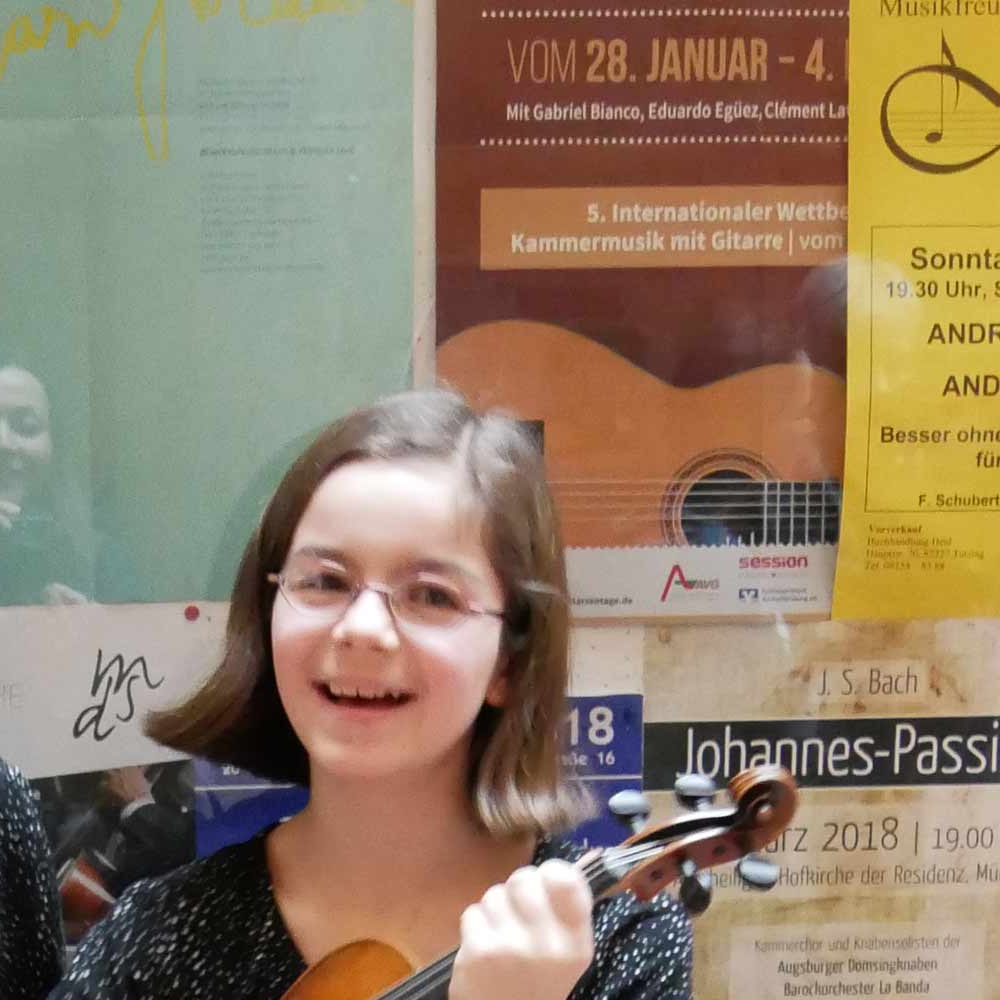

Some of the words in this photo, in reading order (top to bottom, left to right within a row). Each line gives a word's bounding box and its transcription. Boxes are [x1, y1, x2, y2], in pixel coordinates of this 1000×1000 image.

[507, 38, 576, 84] VOM
[586, 38, 636, 83] 28.
[646, 37, 768, 83] JANUAR
[804, 36, 834, 83] 4.
[507, 102, 530, 121] Mit
[533, 101, 587, 121] Gabriel
[591, 101, 645, 124] Bianco,
[648, 100, 711, 120] Eduardo
[715, 100, 763, 124] Egüez,
[765, 99, 826, 120] Clément
[587, 204, 606, 223] 5.
[612, 202, 773, 224] Internationaler
[511, 231, 664, 255] Kammermusik
[671, 231, 706, 251] mit
[712, 229, 784, 251] Gitarre
[799, 234, 844, 250] vom
[886, 279, 939, 299] 19.30
[946, 279, 987, 301] Uhr,
[880, 425, 951, 444] Besser
[738, 555, 809, 569] session
[818, 668, 832, 696] J.
[841, 667, 858, 696] S.
[869, 665, 919, 695] Bach
[596, 750, 616, 766] 16
[822, 816, 899, 852] 2018
[931, 826, 994, 851] 19.00
[859, 863, 885, 886] der
[777, 959, 844, 977] Augsburger
[847, 956, 938, 976] Domsingknaben
[895, 979, 930, 995] Banda
